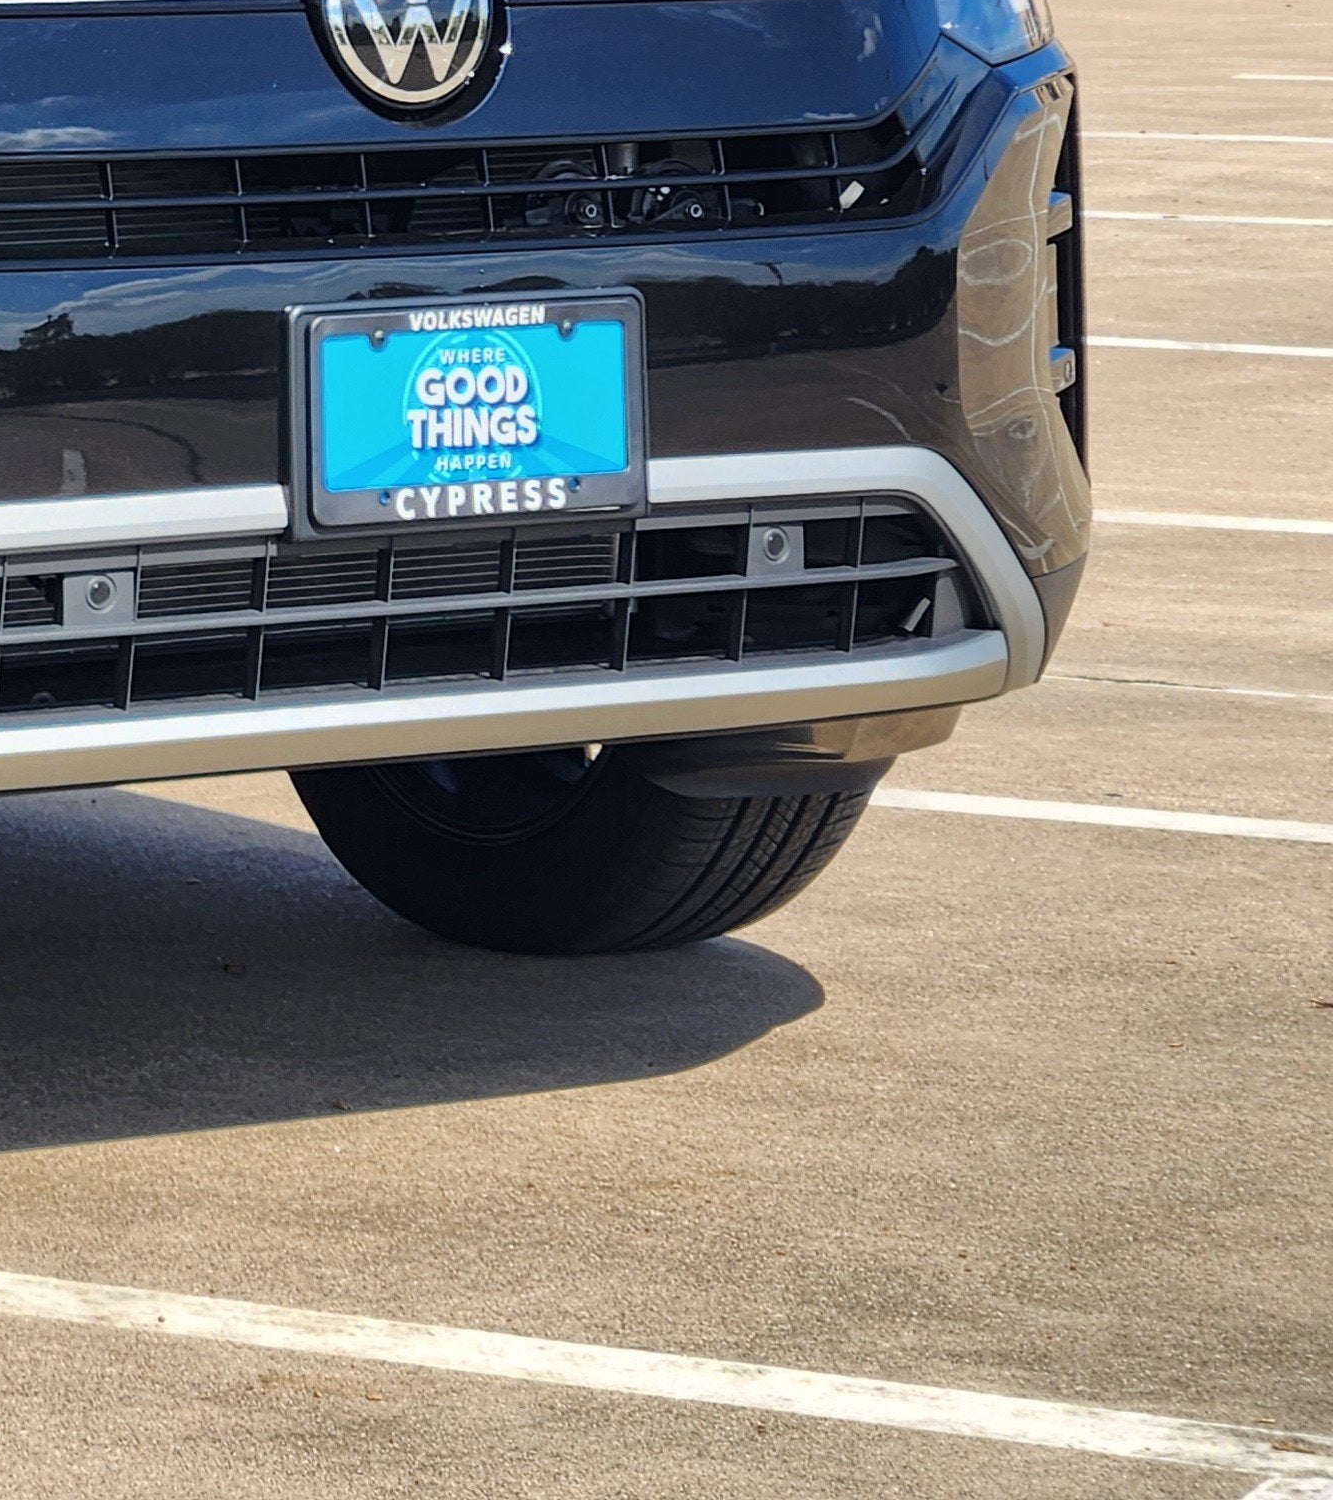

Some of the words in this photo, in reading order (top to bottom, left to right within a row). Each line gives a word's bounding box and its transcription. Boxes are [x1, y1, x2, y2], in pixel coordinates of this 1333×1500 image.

[409, 304, 547, 332] VOLKSWAGEN
[438, 347, 507, 366] WHERE
[416, 365, 529, 407] GOOD
[406, 407, 538, 450] THINGS
[435, 452, 513, 472] HAPPEN
[395, 478, 567, 521] CYPRESS
